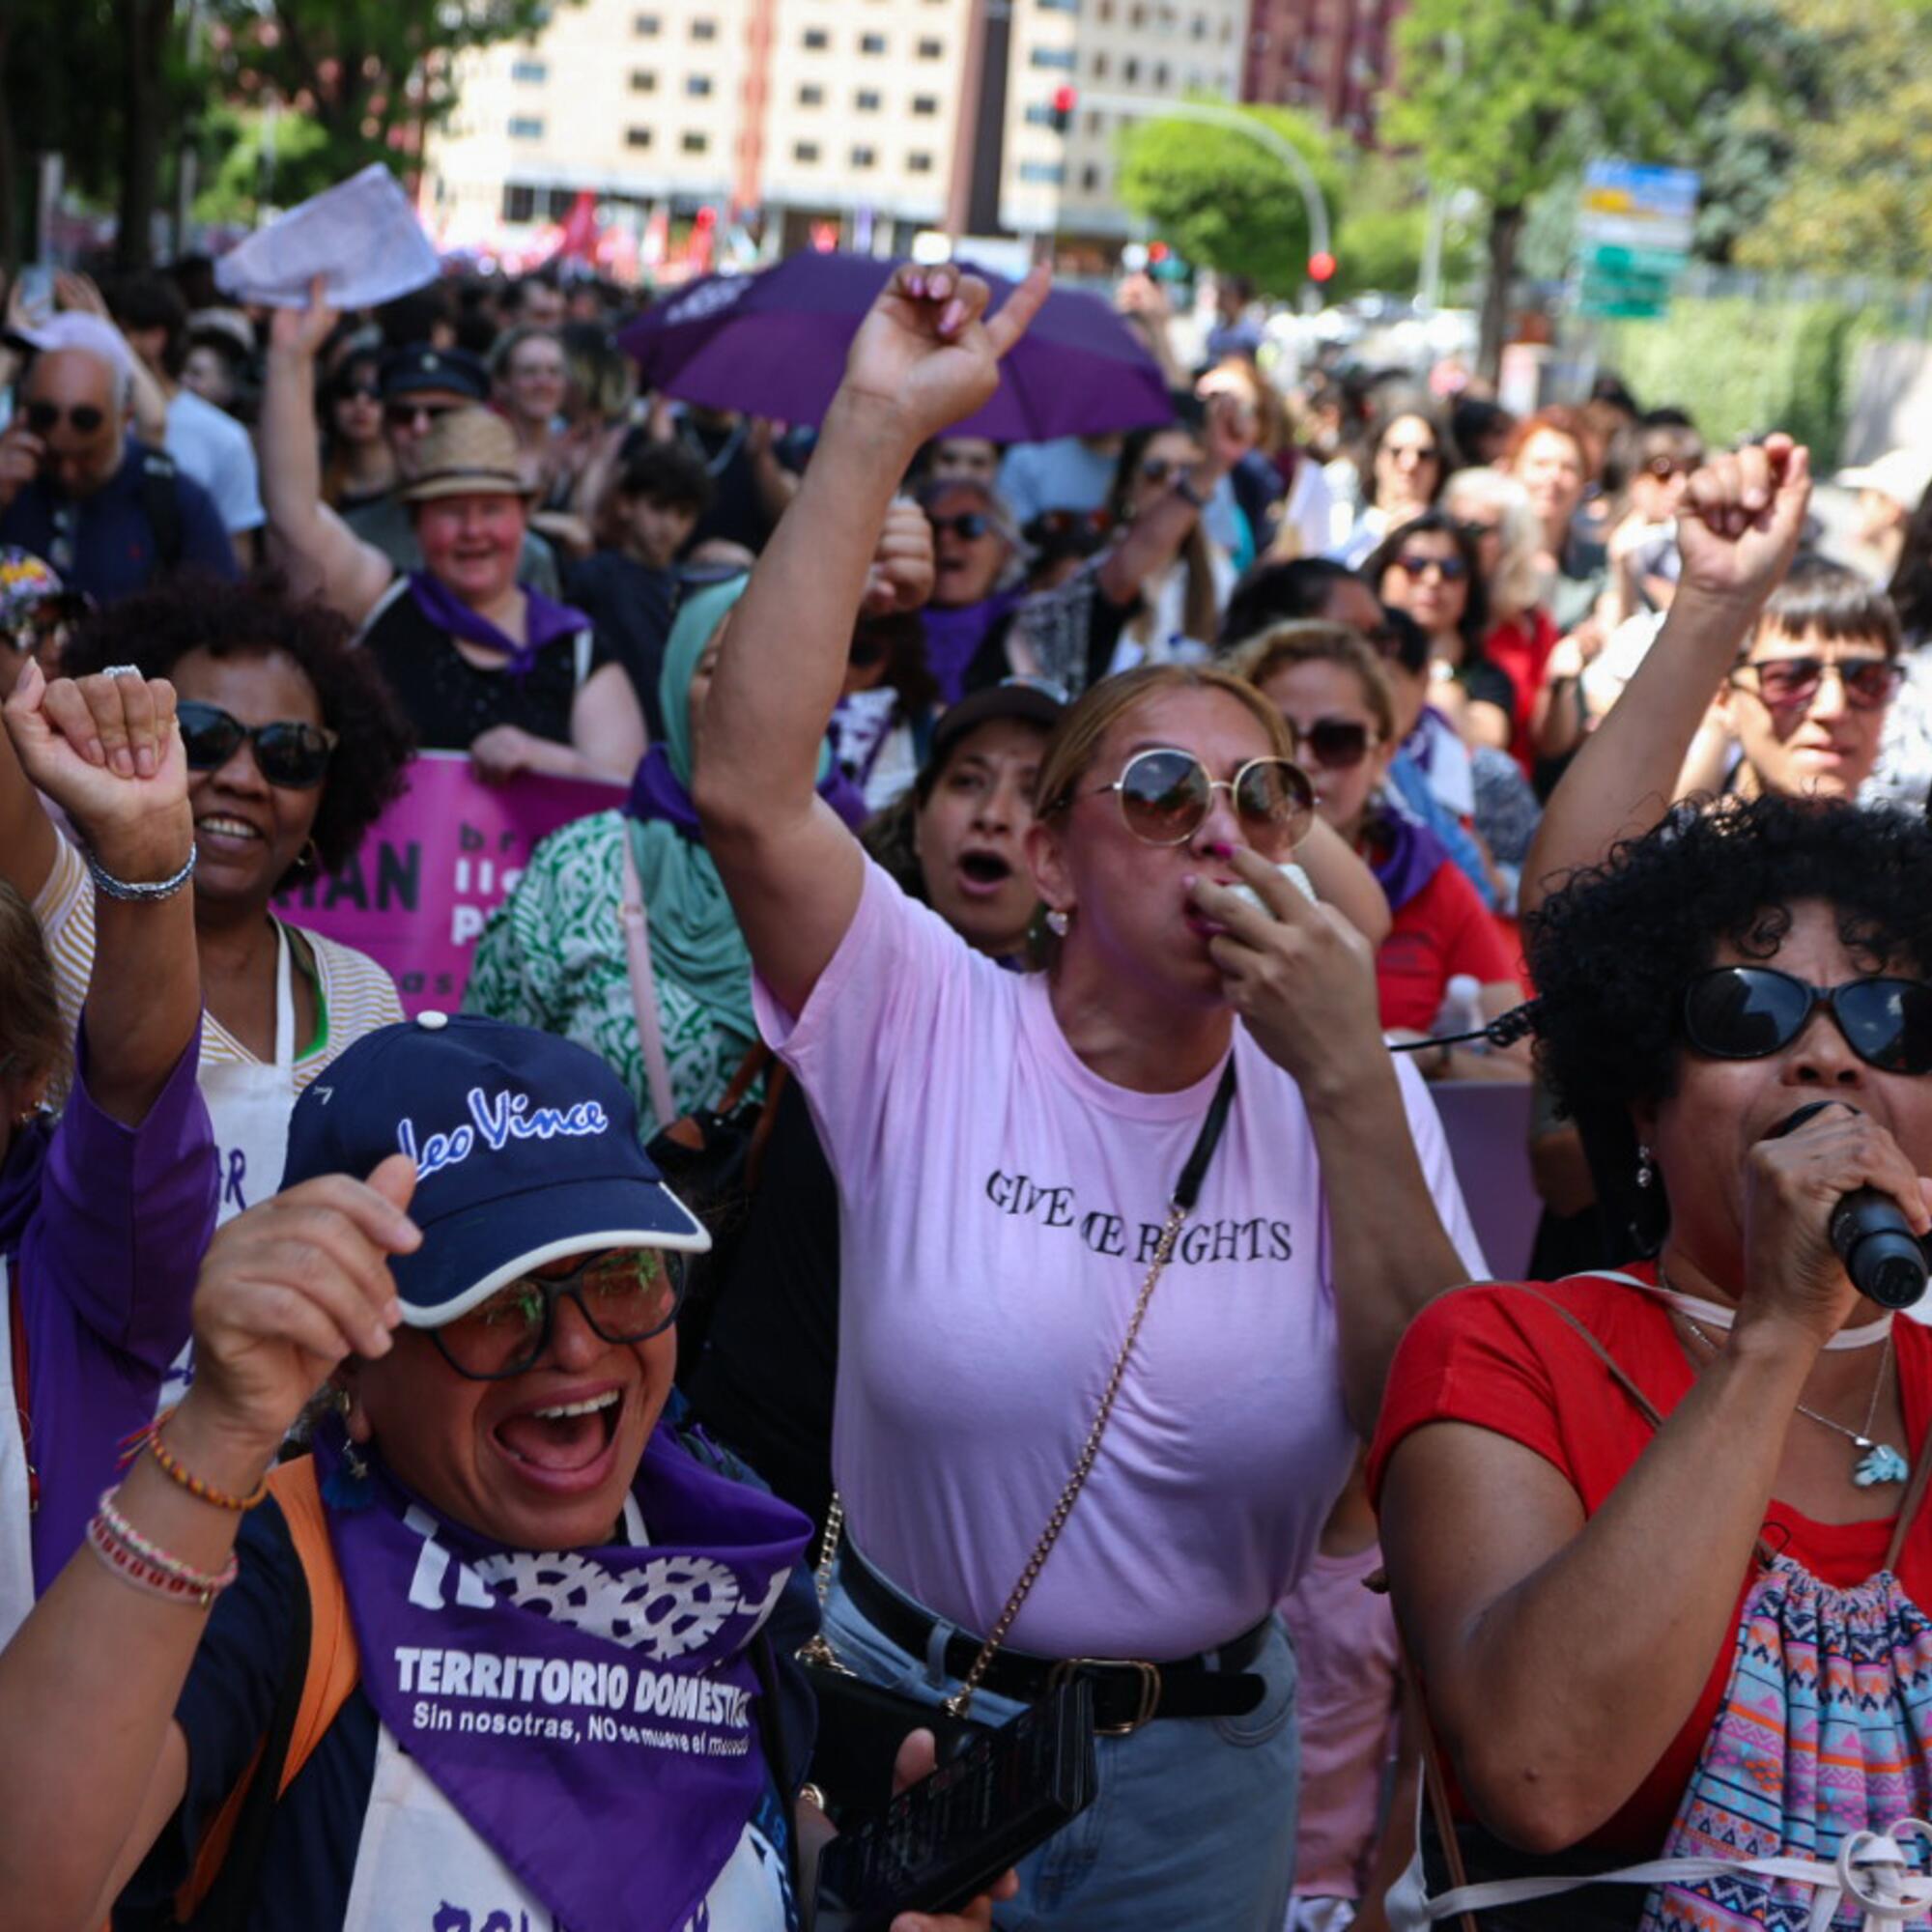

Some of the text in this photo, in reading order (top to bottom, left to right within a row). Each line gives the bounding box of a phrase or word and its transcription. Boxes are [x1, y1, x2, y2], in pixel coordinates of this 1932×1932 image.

[985, 1169, 1075, 1228] GIVE
[1133, 1216, 1293, 1264] RIGHTS
[394, 1646, 629, 1710] TERRITORIO
[412, 1701, 453, 1730] Sin
[459, 1710, 581, 1746] nosotras,
[588, 1713, 618, 1743] NO
